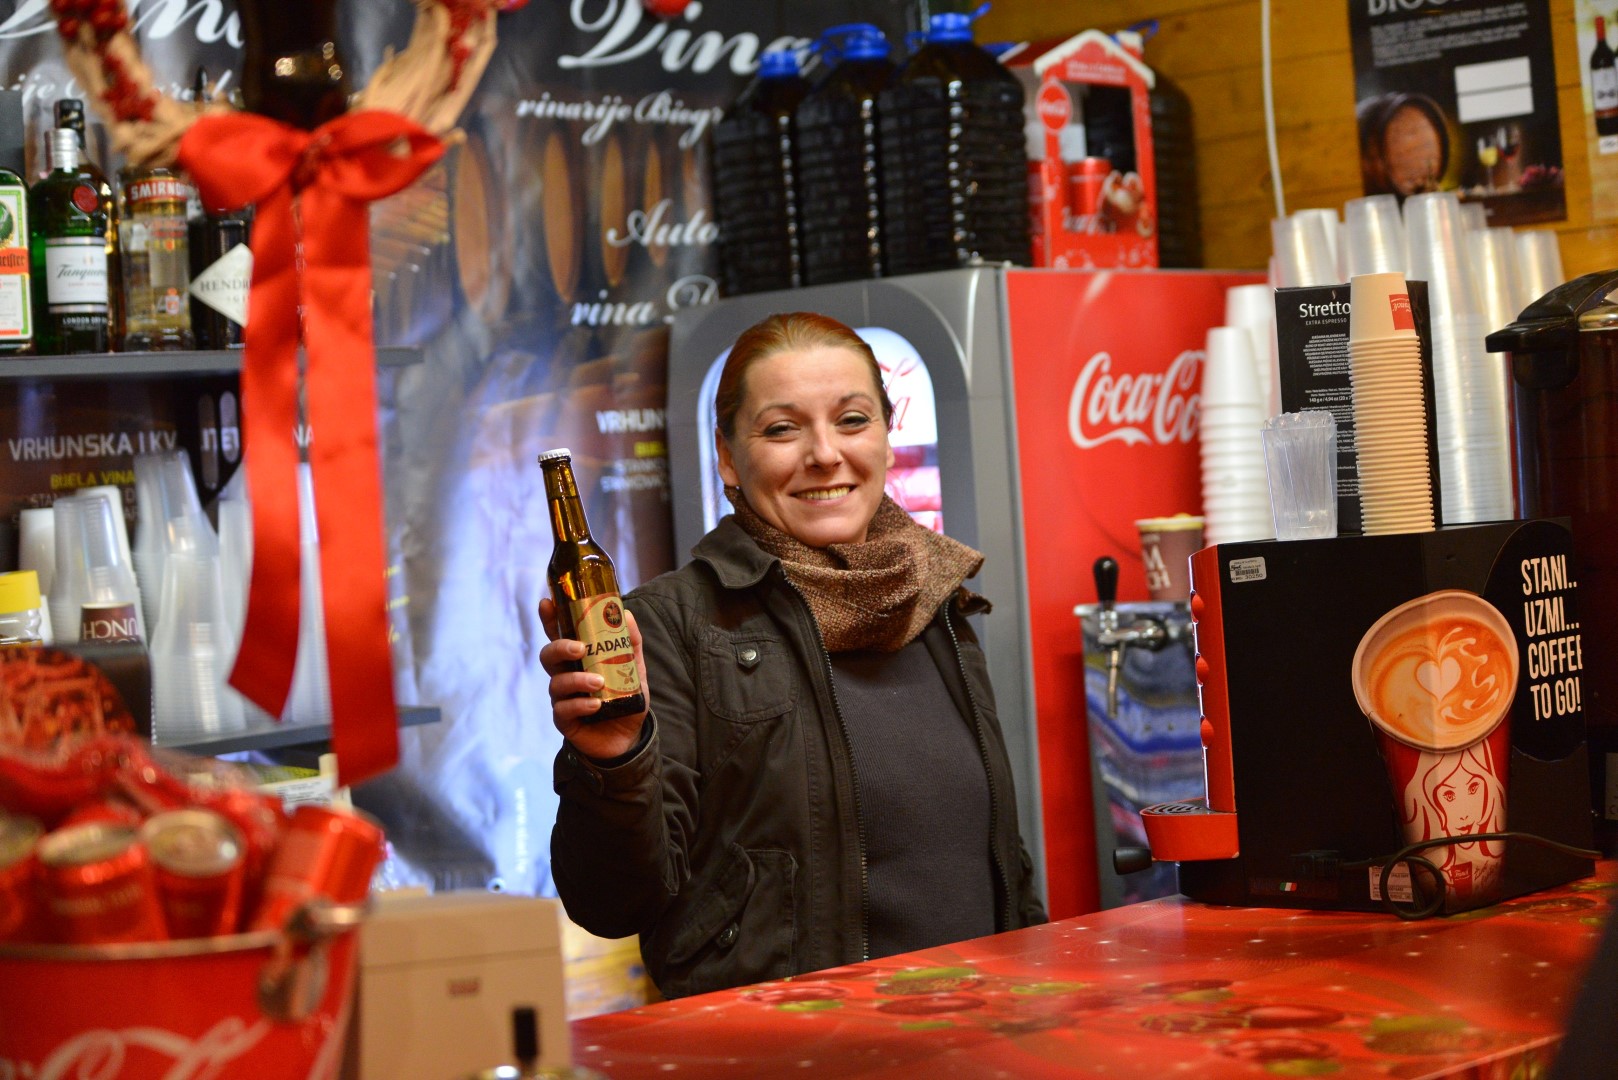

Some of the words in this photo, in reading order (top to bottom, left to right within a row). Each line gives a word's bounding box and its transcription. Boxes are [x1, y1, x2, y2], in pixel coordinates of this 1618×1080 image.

[1299, 301, 1351, 318] Stretto
[1322, 317, 1347, 325] ESPRESSO
[8, 432, 133, 462] VRHUNSKA
[1521, 554, 1577, 596] STANI..
[1524, 596, 1580, 638] UZMI...
[1530, 682, 1552, 721] TO
[1554, 676, 1581, 716] GO!
